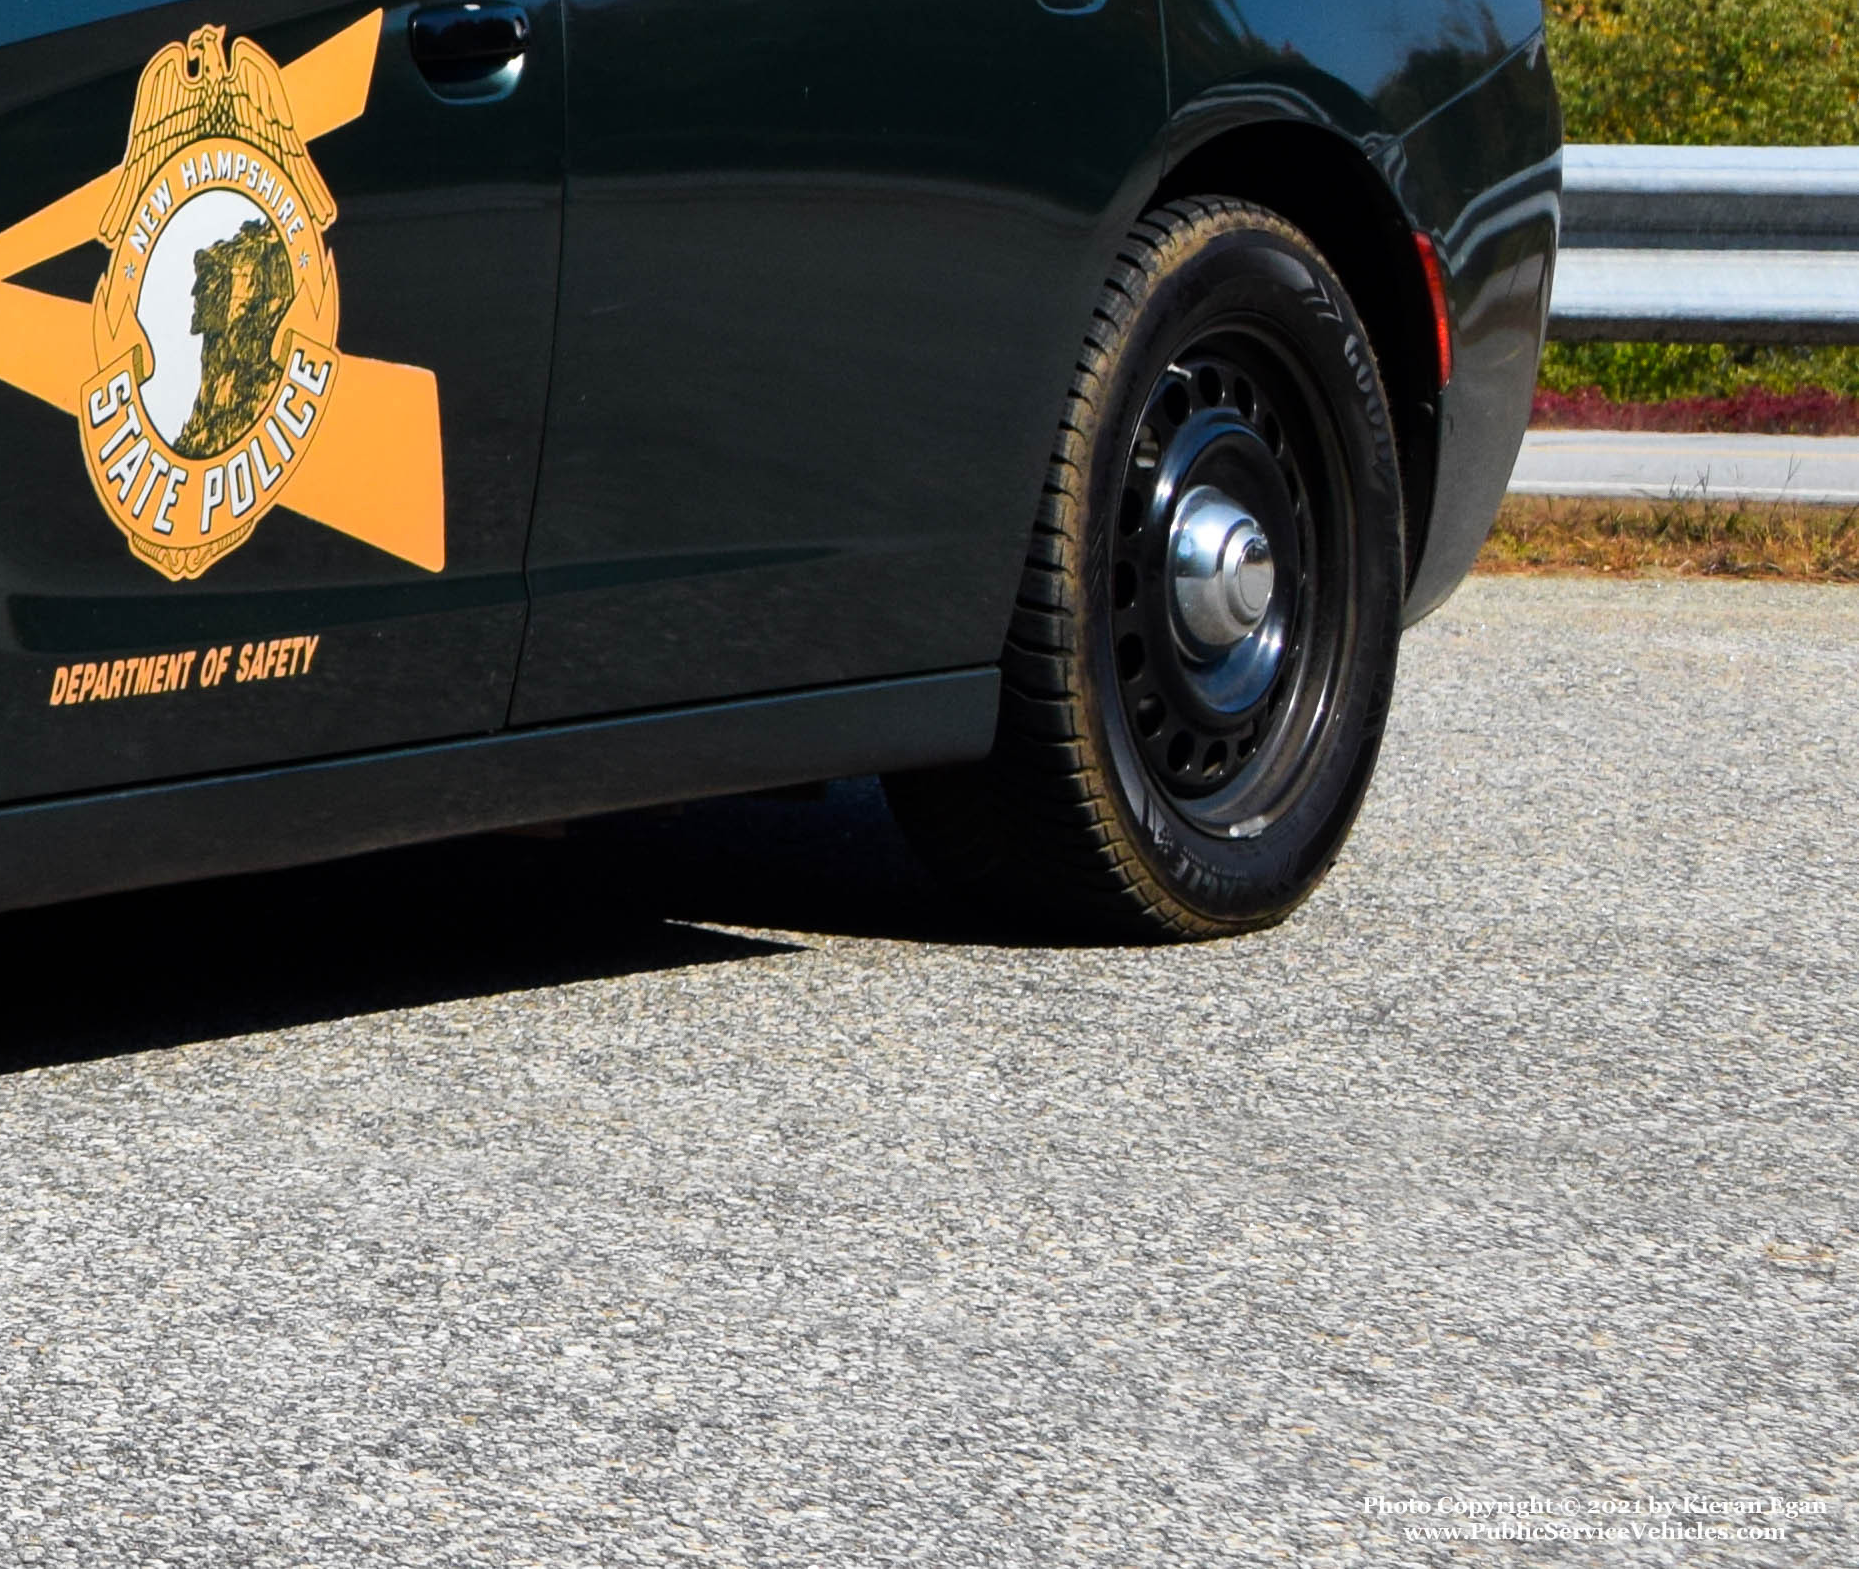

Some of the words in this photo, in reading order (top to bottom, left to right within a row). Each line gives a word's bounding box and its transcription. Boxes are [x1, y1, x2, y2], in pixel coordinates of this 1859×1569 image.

[129, 179, 174, 254] NEW
[180, 150, 306, 244] HAMPSHIRE
[89, 370, 189, 535] STATE
[199, 348, 333, 535] POLICE
[49, 650, 197, 706] DEPARTMENT
[199, 645, 233, 688] OF
[235, 634, 320, 683] SAFETY
